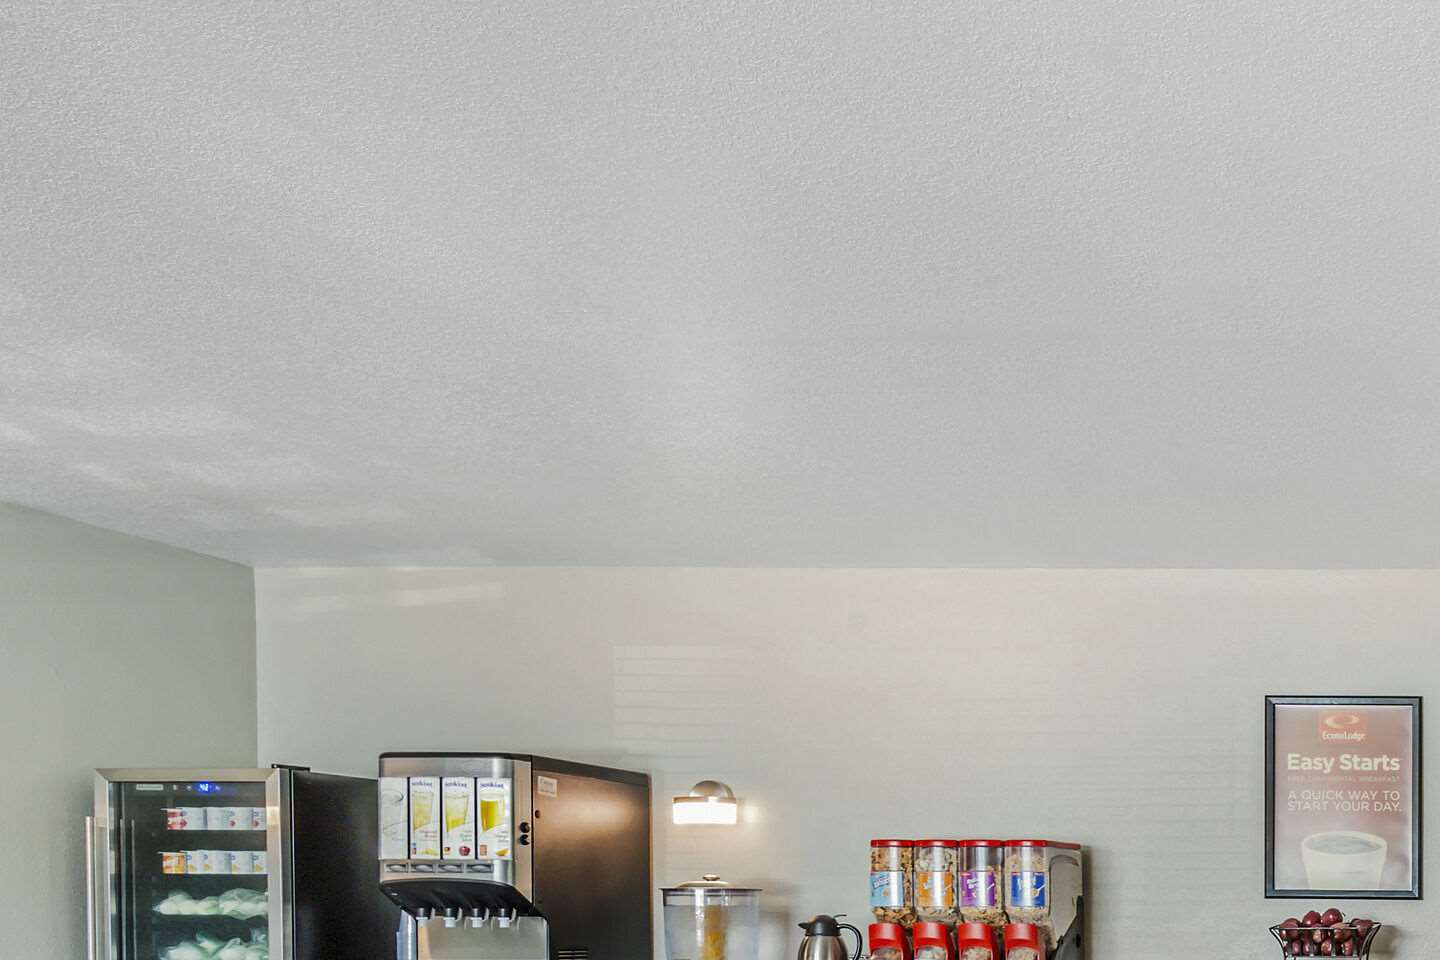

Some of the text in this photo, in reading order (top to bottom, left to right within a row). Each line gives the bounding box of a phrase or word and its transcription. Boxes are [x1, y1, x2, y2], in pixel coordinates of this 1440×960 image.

[1287, 753, 1401, 773] Easy Starts
[1287, 790, 1401, 801] A QUICK WAY TO
[1287, 801, 1403, 812] START YOUR DAY.
